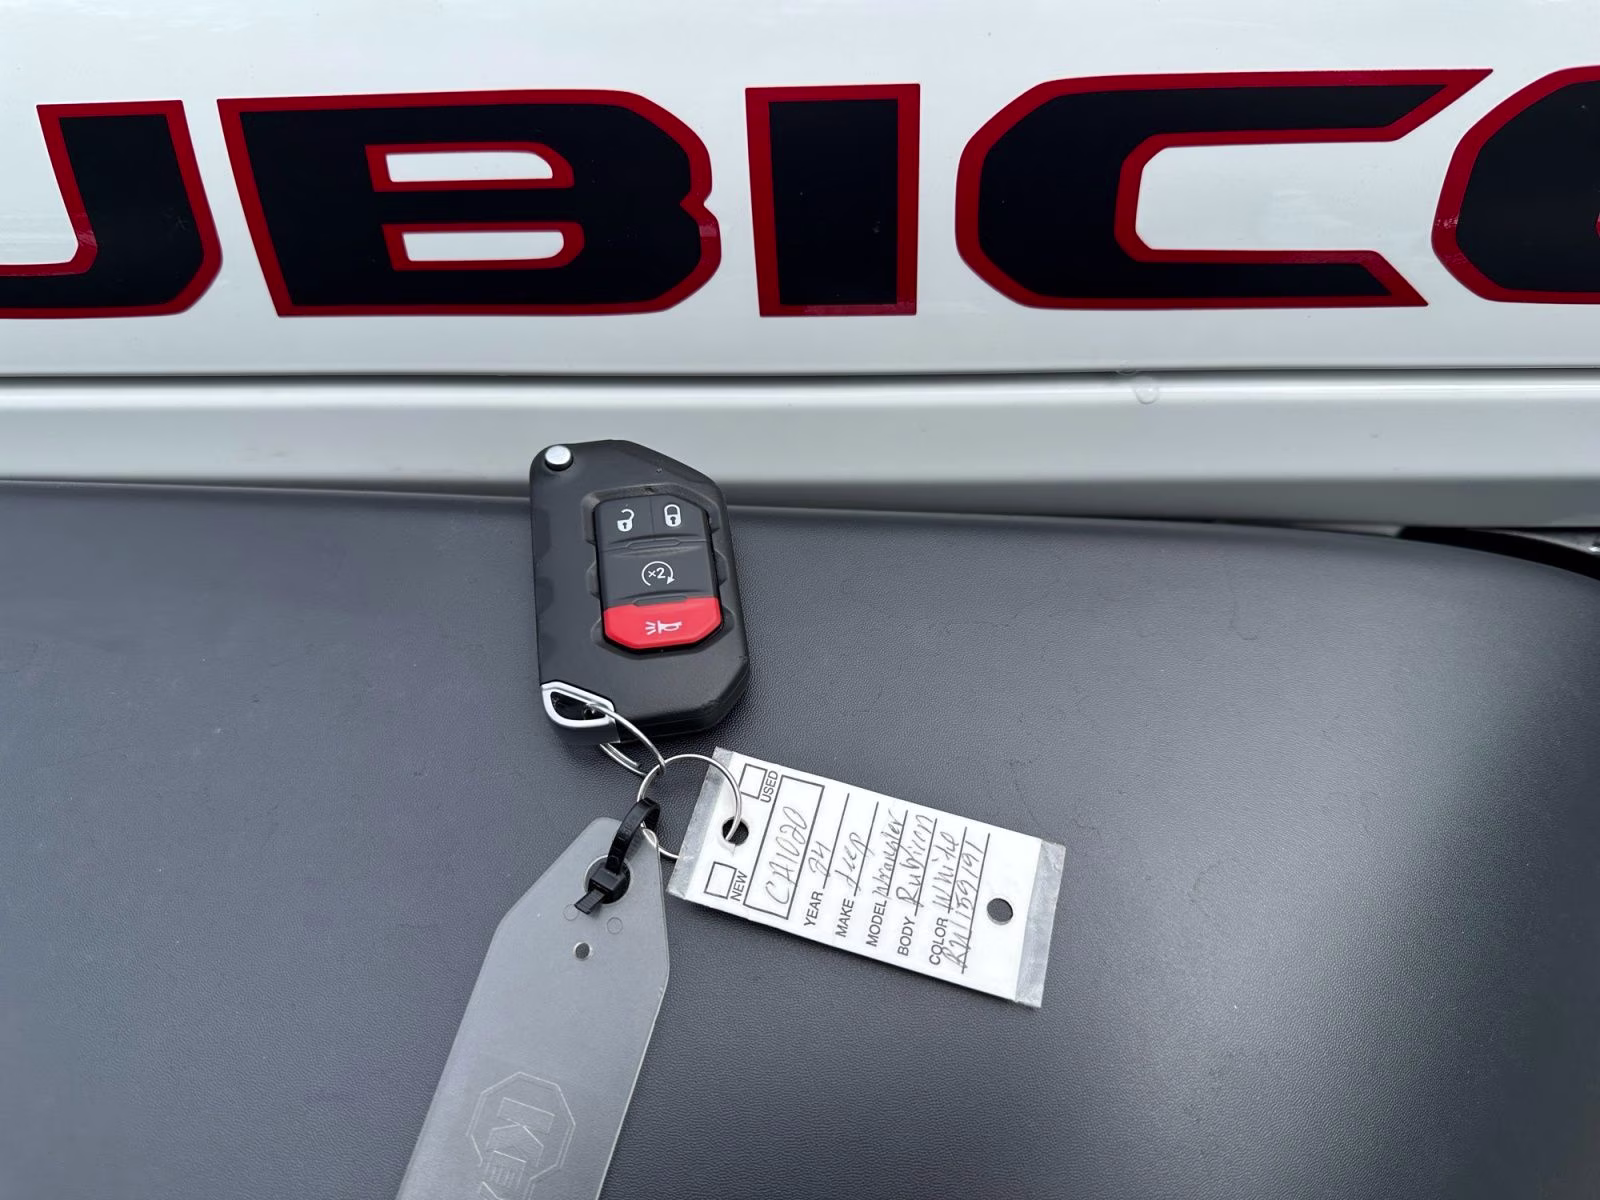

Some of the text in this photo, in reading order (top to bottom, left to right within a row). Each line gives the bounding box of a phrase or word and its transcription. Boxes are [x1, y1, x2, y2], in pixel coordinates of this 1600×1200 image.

[760, 770, 779, 803] USED
[730, 870, 748, 901] NEW
[803, 840, 832, 928] YEAR 24
[835, 898, 855, 938] MAKE
[866, 900, 887, 948] MODEL
[897, 916, 916, 957] BODY
[928, 917, 949, 966] COLOR
